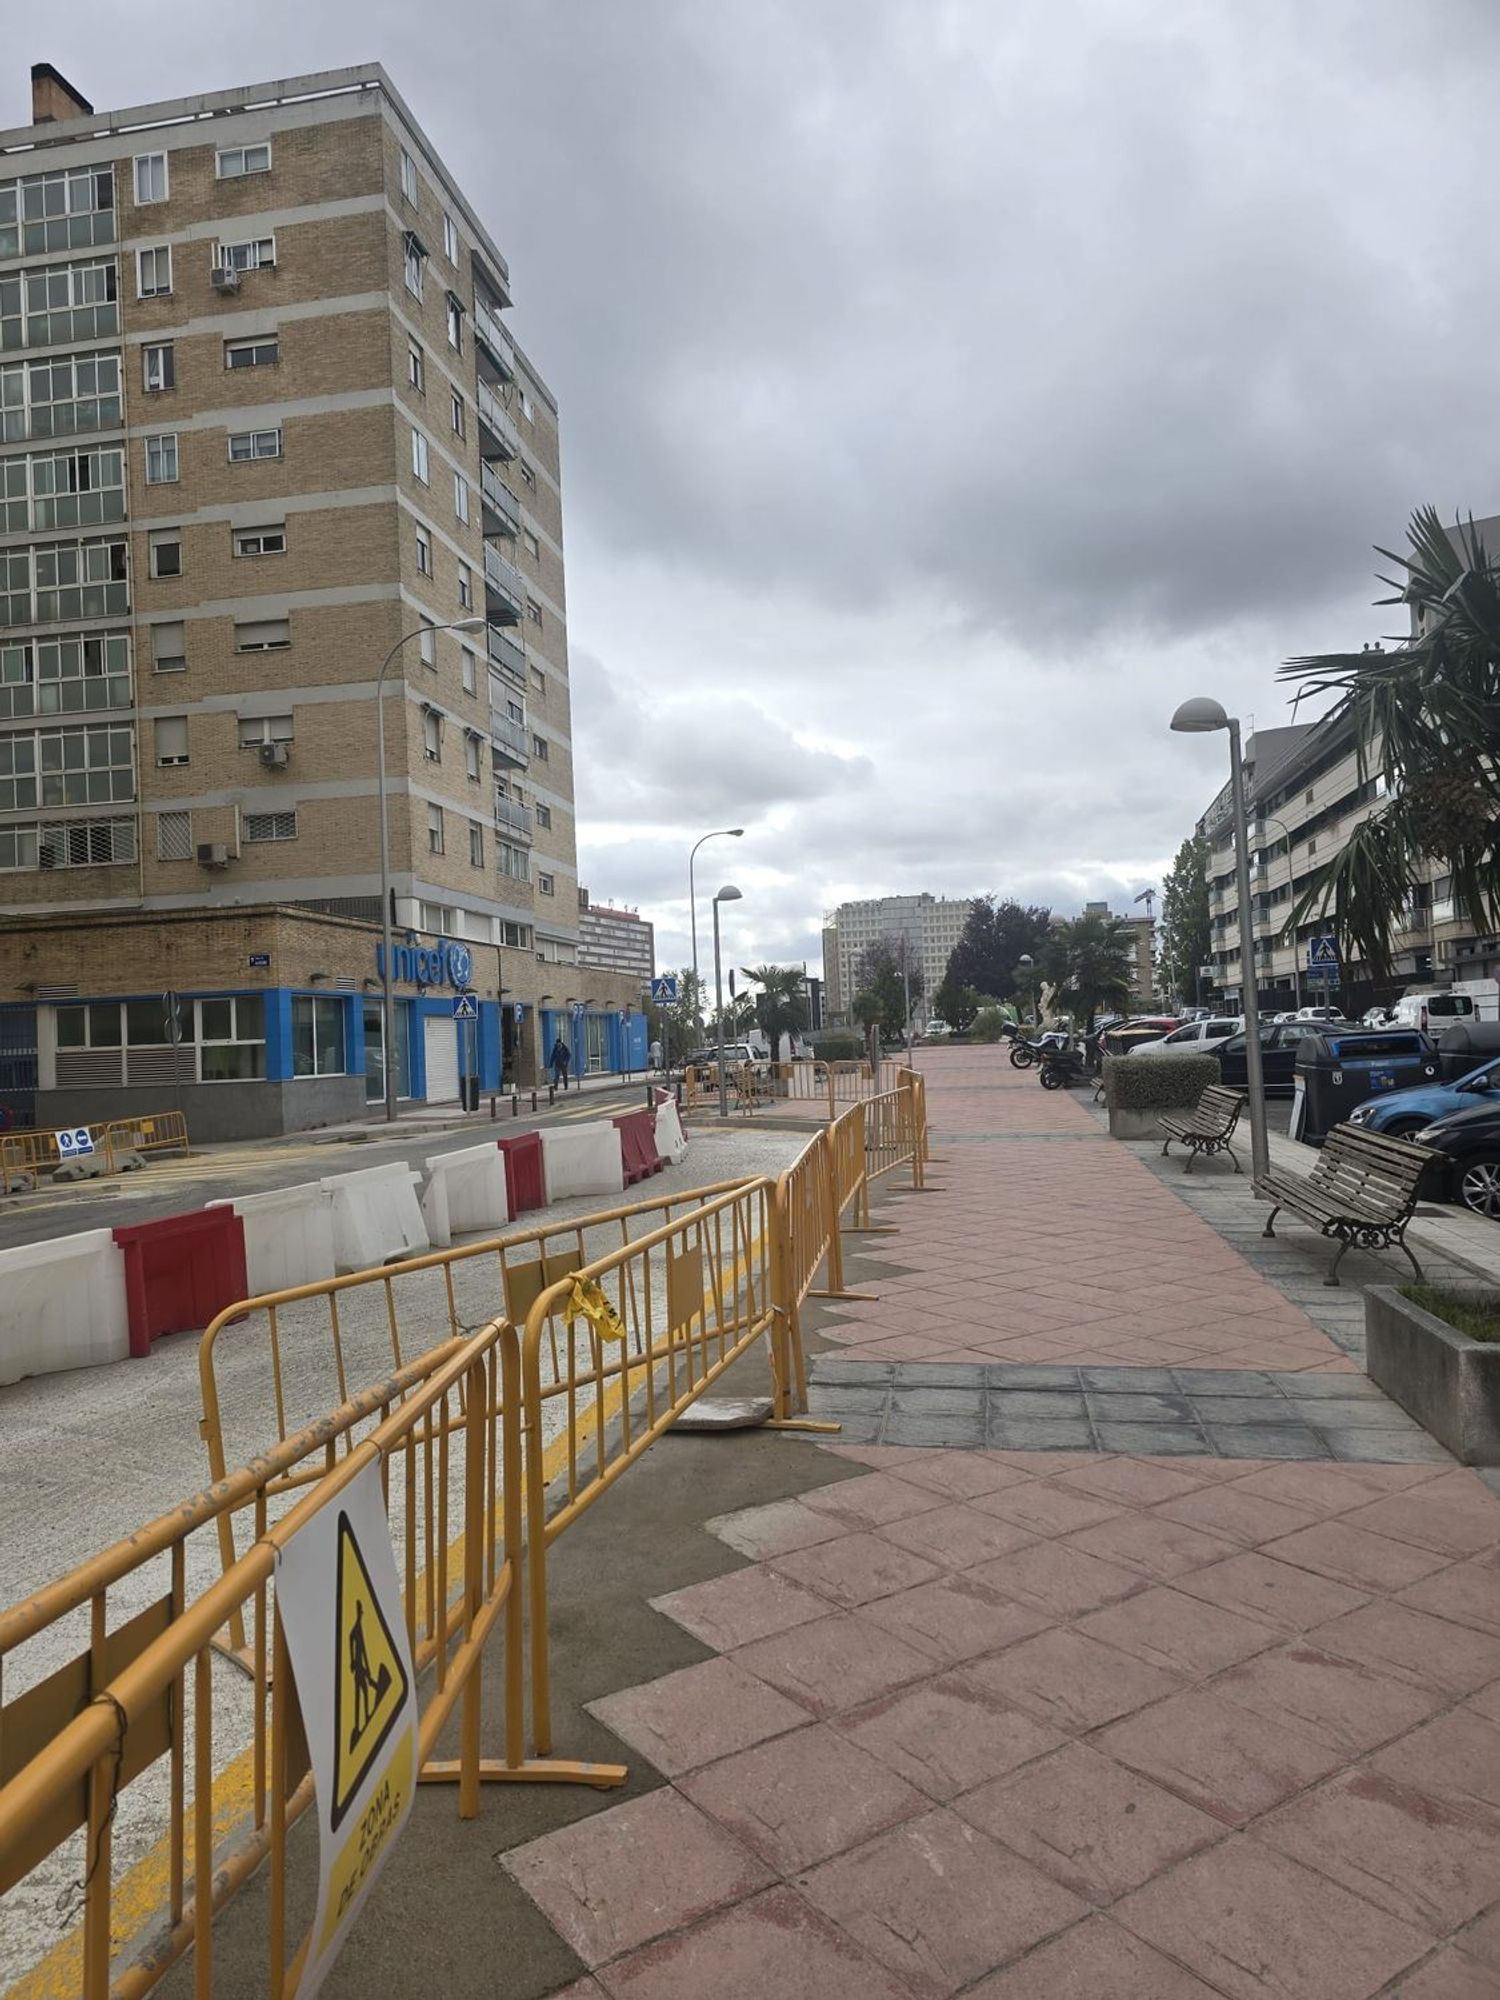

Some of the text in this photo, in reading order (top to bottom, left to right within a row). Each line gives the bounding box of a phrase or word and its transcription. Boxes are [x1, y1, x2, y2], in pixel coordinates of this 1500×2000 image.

[376, 932, 447, 985] unicef
[359, 1779, 390, 1852] ZONA
[337, 1867, 359, 1917] DE
